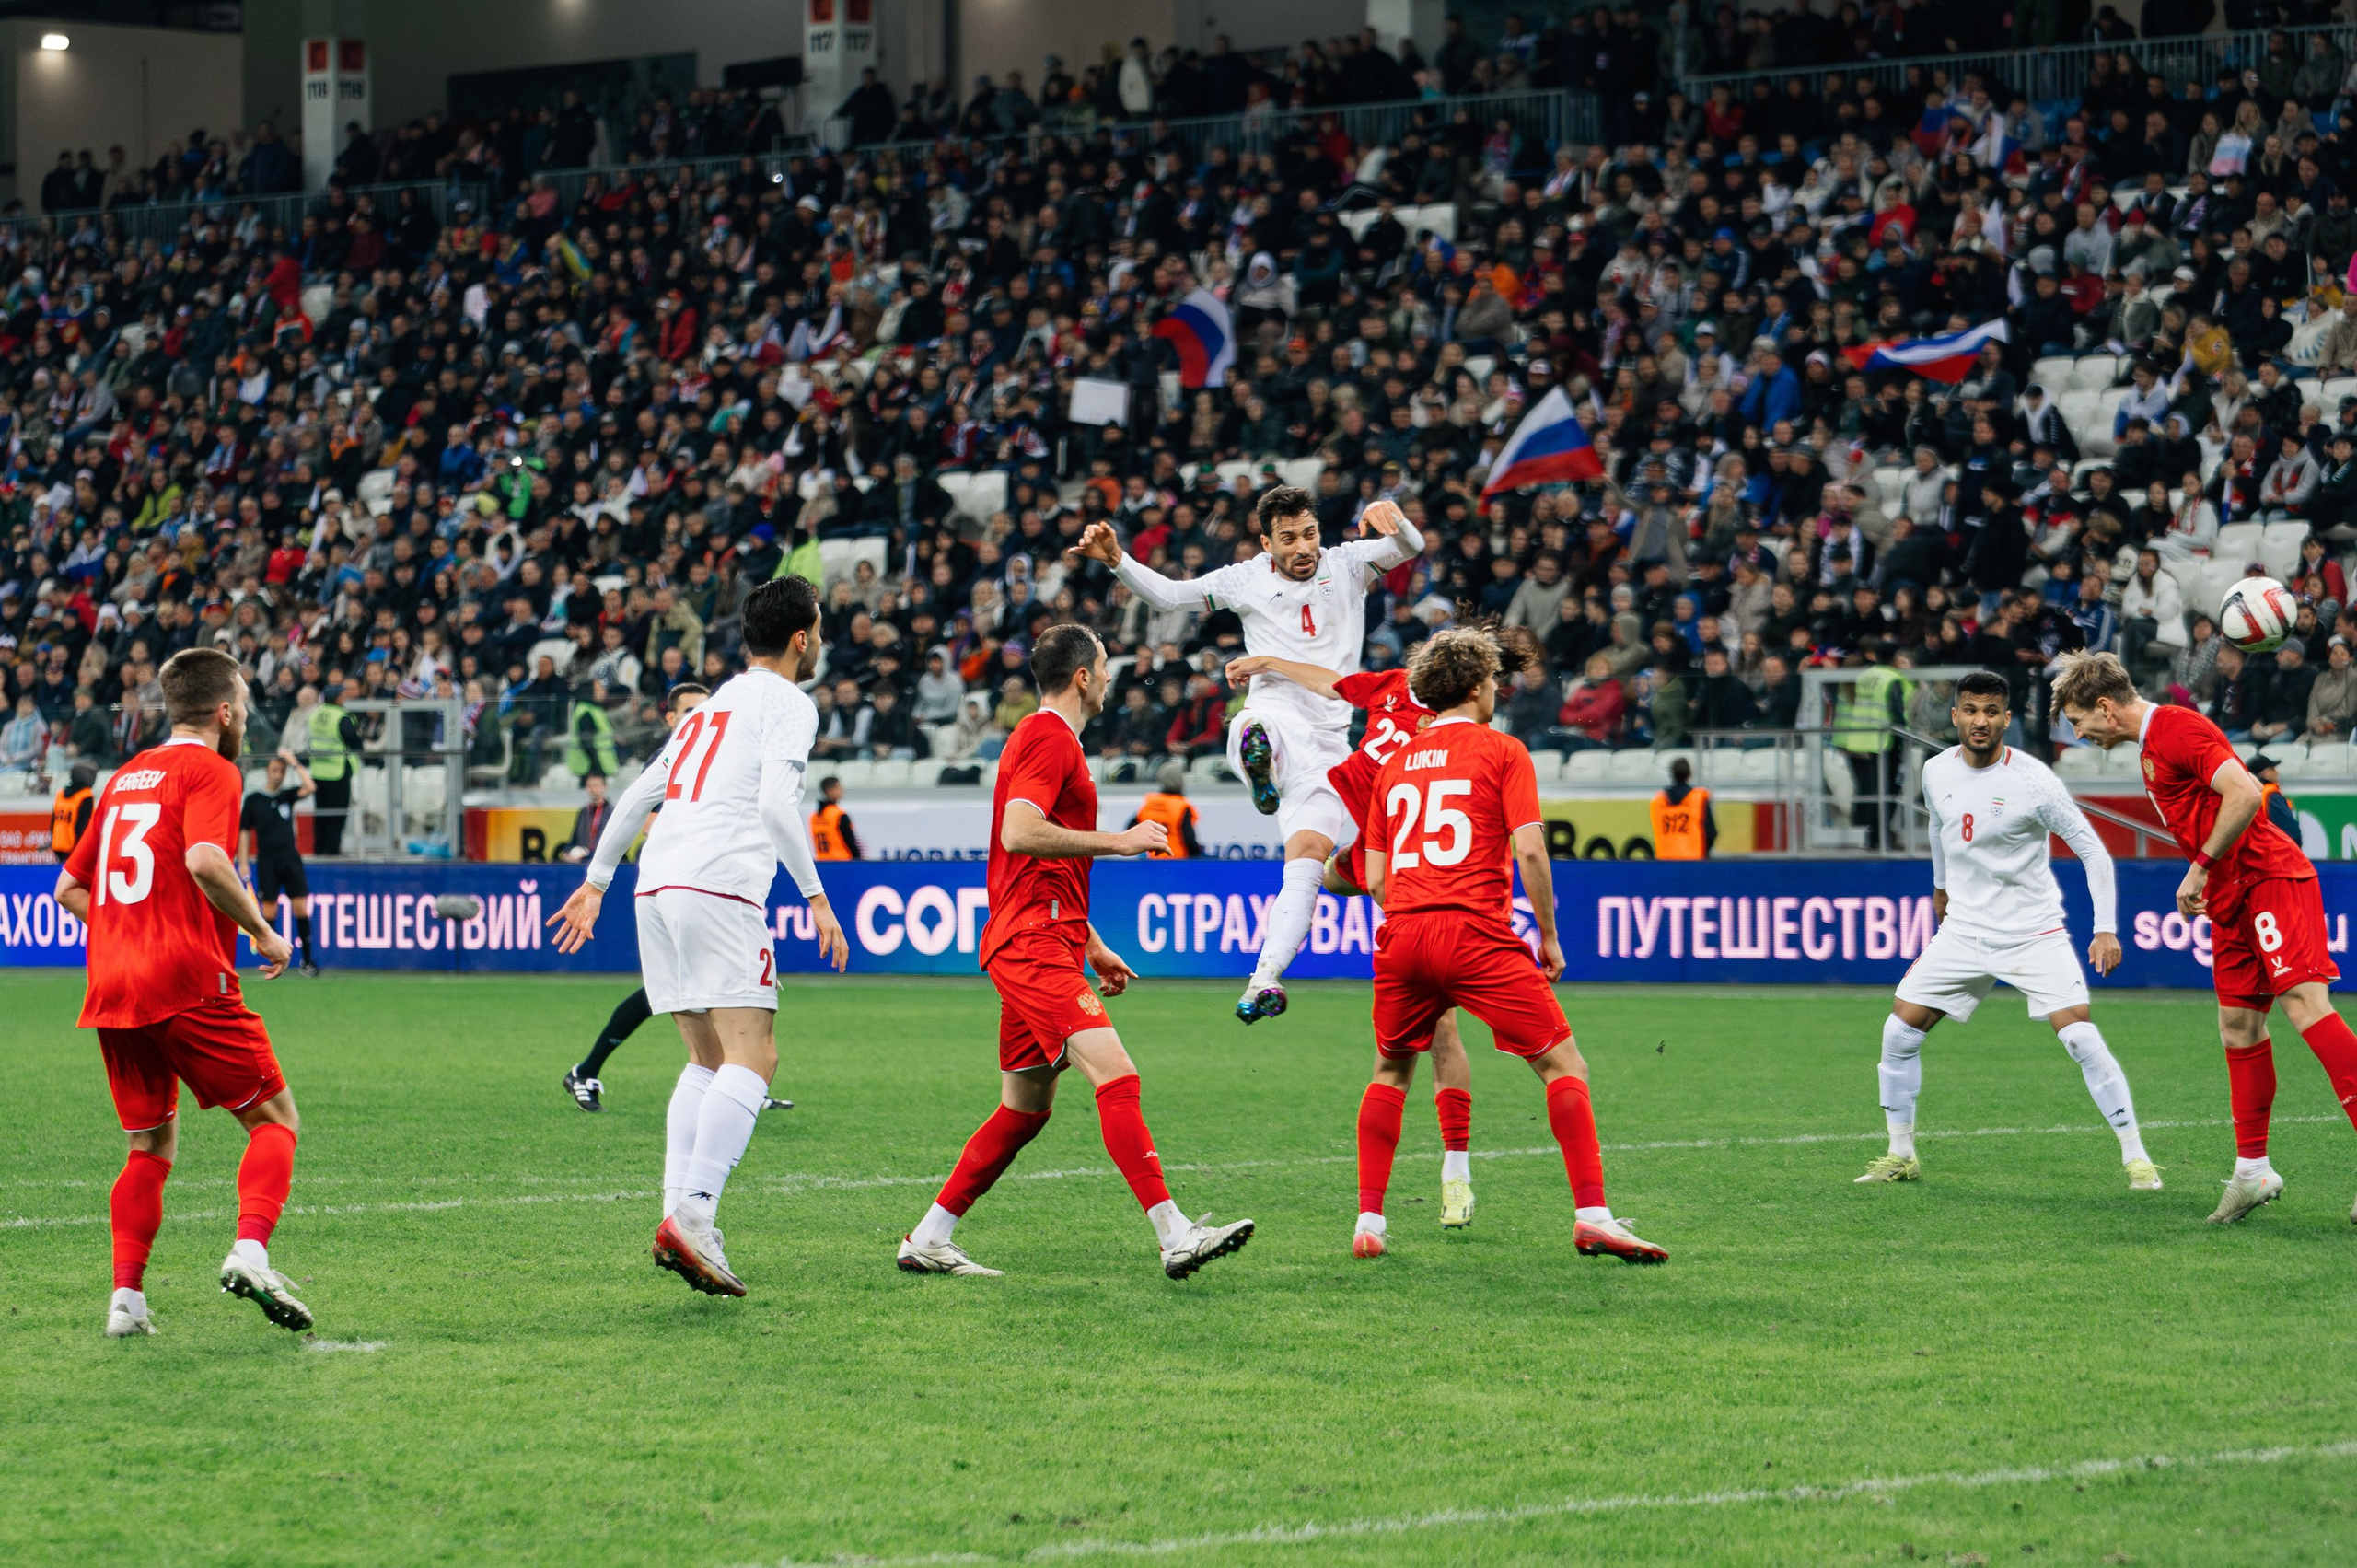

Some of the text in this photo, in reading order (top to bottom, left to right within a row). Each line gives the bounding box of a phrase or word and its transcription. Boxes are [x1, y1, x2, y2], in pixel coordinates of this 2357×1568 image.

[809, 30, 832, 53] 117
[845, 31, 869, 52] 117
[307, 80, 328, 101] 118
[338, 79, 364, 101] 118
[1301, 604, 1316, 637] 4
[665, 711, 732, 803] 27
[1404, 749, 1449, 772] LUKIN
[1387, 779, 1472, 875] 25
[1961, 812, 1974, 842] 8
[98, 803, 161, 907] 13
[2255, 911, 2283, 953] 8
